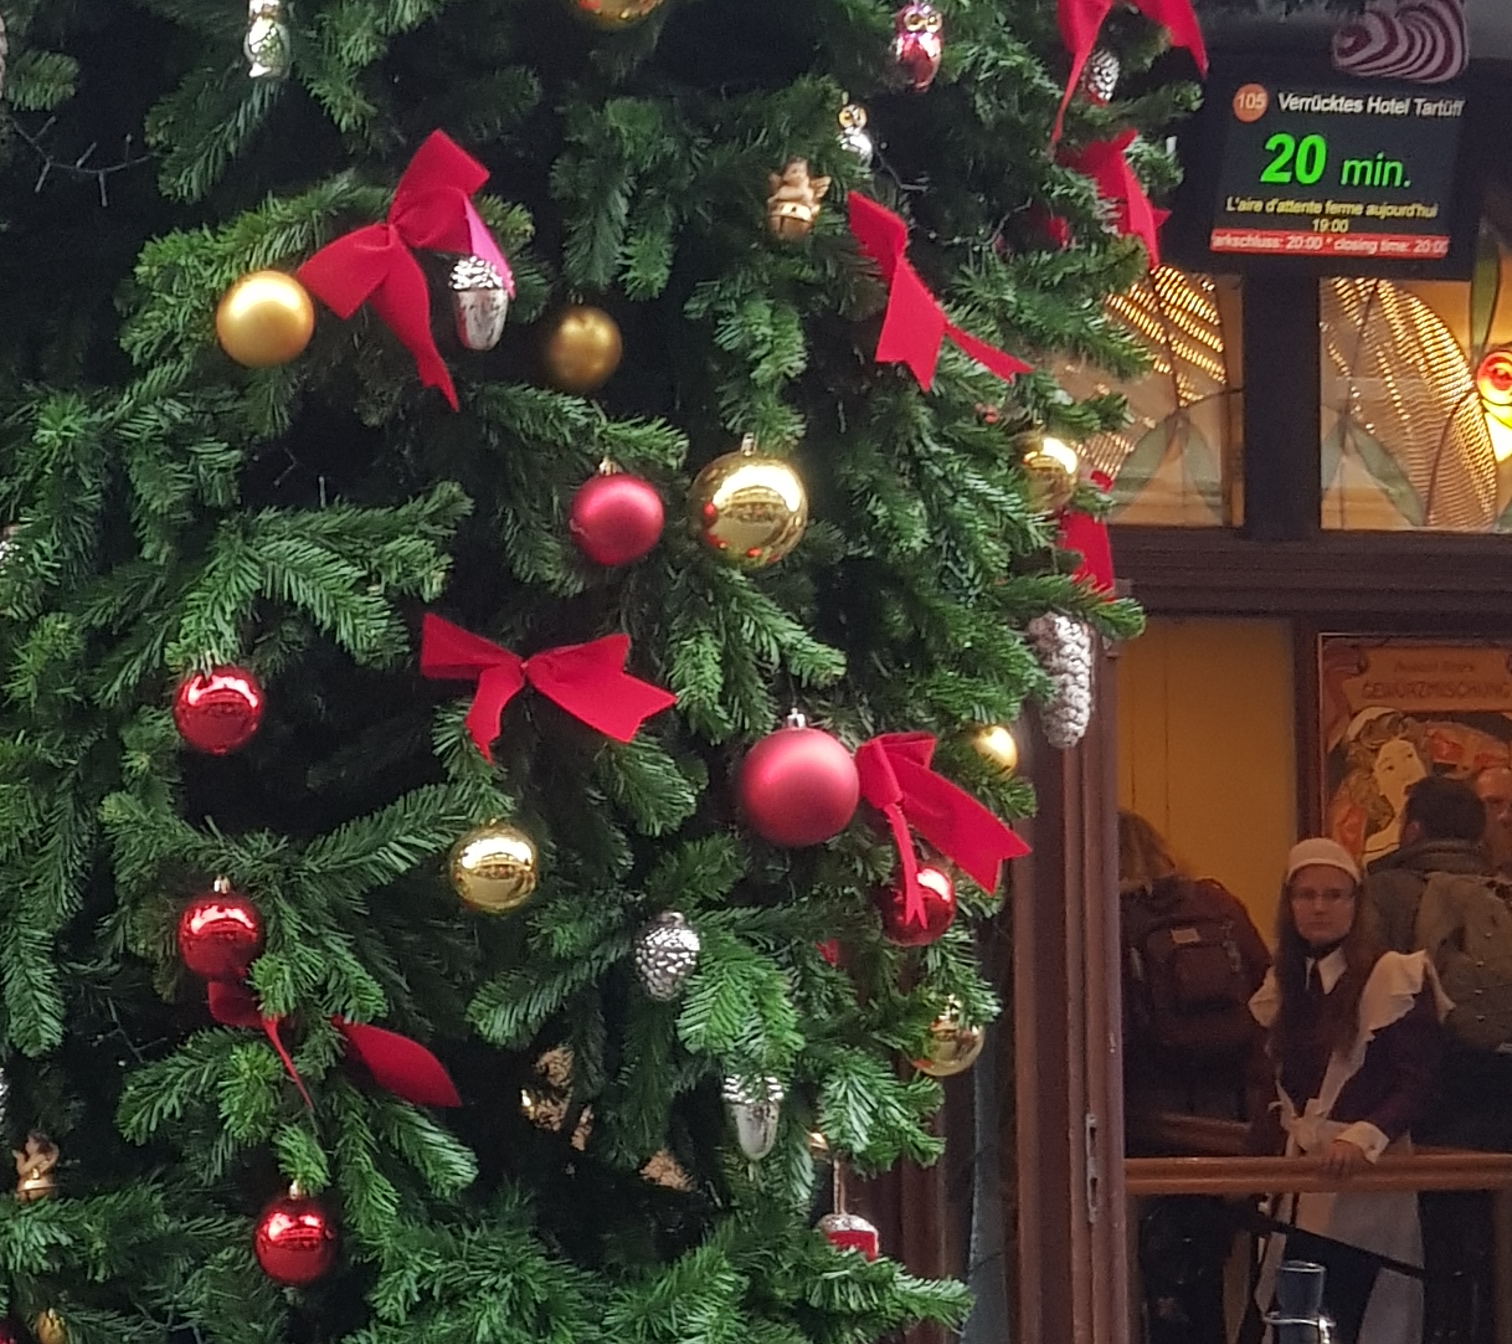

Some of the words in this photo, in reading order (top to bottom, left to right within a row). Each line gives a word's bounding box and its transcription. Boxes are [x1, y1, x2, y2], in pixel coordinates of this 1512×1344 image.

[1238, 92, 1266, 109] 105
[1278, 92, 1363, 114] Verrücktes
[1366, 96, 1409, 115] Hotel
[1260, 133, 1327, 185] 20
[1340, 152, 1411, 188] min.
[1226, 196, 1263, 213] L'aire
[1312, 218, 1348, 233] 19:00
[1286, 235, 1322, 251] 20:00
[1334, 236, 1378, 255] closing
